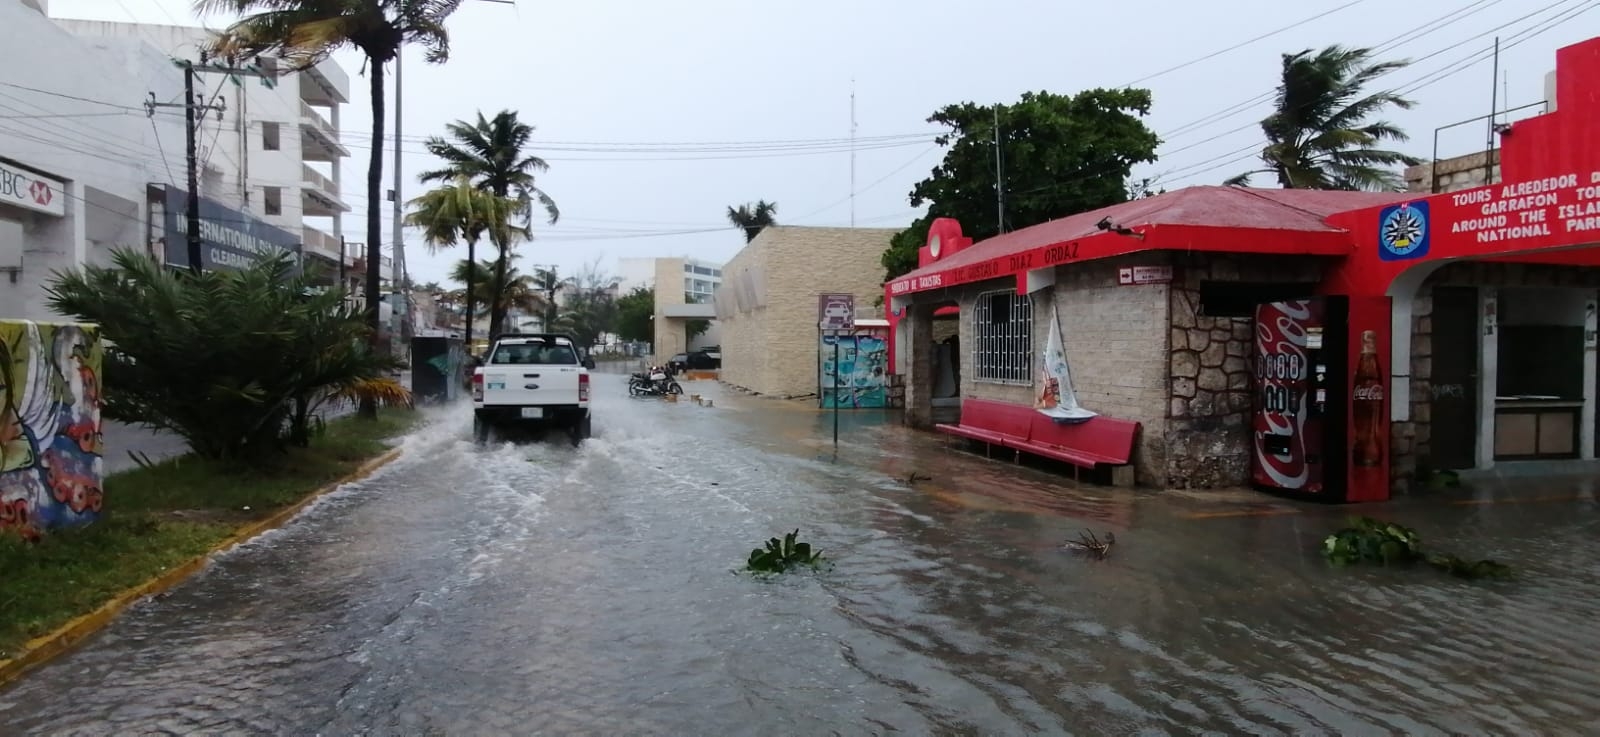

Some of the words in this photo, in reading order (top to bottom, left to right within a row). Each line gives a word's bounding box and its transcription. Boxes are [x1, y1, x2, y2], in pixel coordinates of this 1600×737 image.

[0, 167, 26, 199] BC
[1452, 189, 1492, 207] TOURS
[1502, 174, 1577, 198] ALREDEDOR
[1591, 171, 1600, 184] D
[1481, 193, 1557, 215] GARRAFON
[176, 212, 258, 253] INERNATIONAL
[1452, 215, 1507, 233] AROUND
[1519, 209, 1546, 224] THE
[1477, 223, 1551, 243] NATIONAL
[1010, 254, 1033, 271] DIAZ
[1044, 242, 1079, 264] ORDAZ
